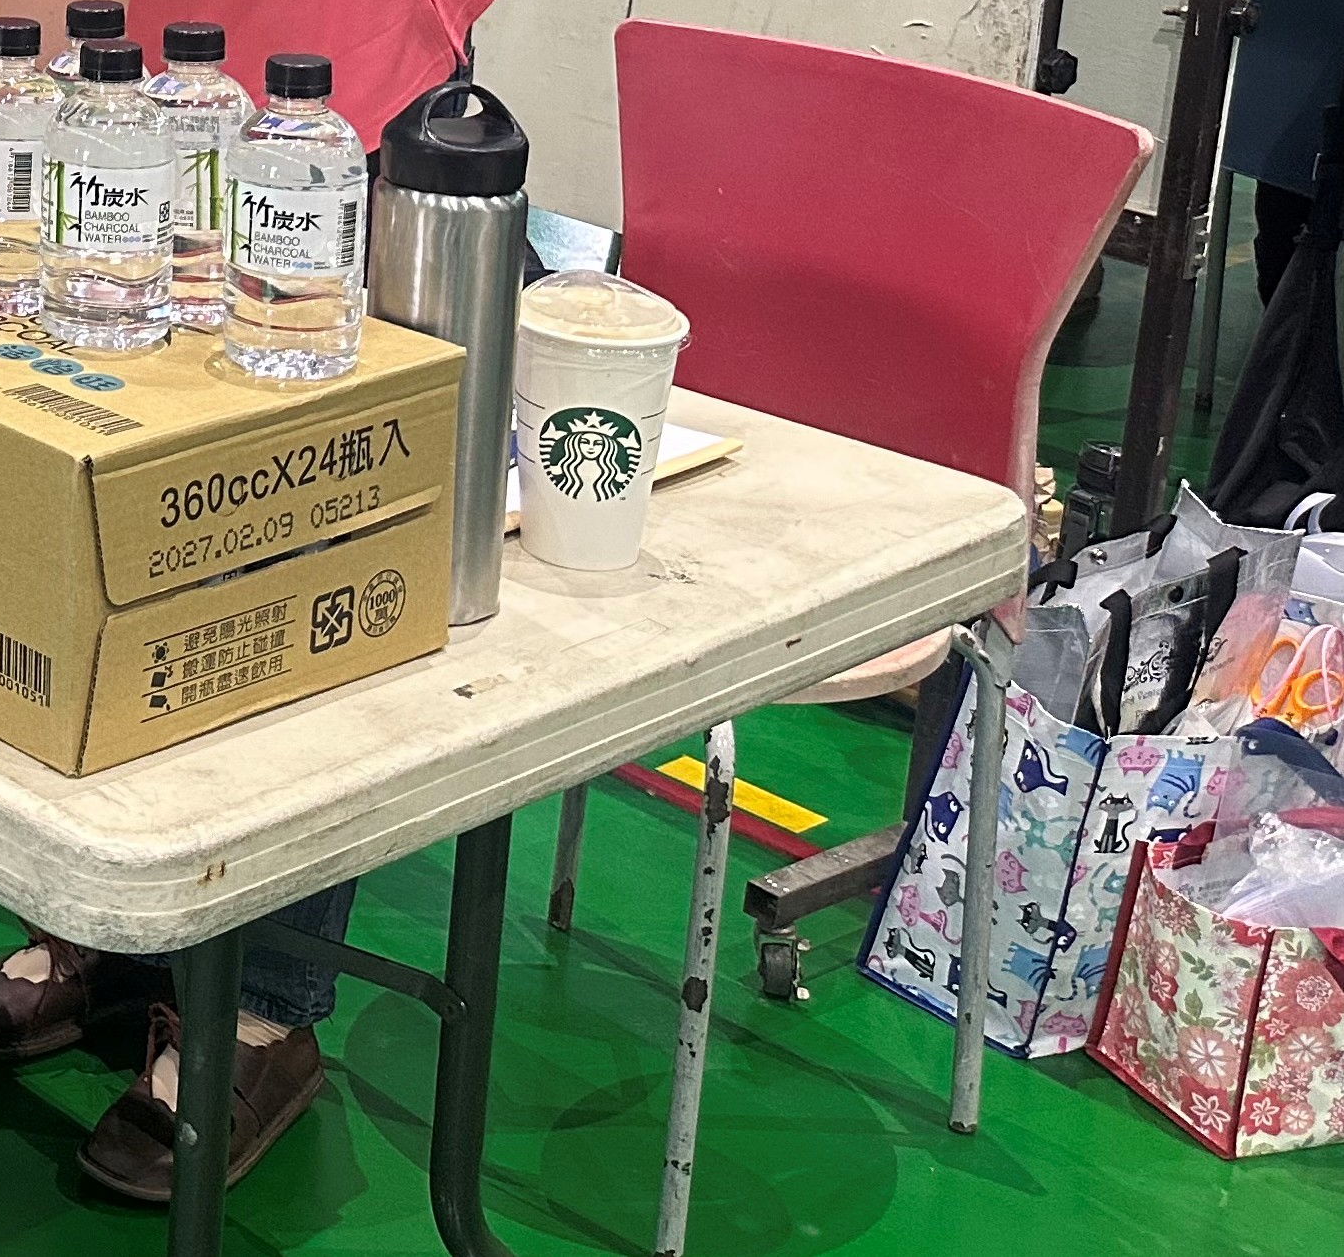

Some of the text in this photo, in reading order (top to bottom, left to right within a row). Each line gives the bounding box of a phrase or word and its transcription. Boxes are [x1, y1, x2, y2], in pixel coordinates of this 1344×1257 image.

[70, 172, 150, 208] 竹炭水
[84, 210, 130, 222] BAMBOO
[242, 191, 324, 232] 竹炭水
[84, 222, 141, 233] CHARCOAL
[84, 233, 122, 243] WATER
[254, 232, 301, 247] BAMBOO
[253, 243, 312, 259] CHARCOAL
[253, 253, 291, 269] WATER
[160, 418, 411, 528] 360ccX24瓶入
[148, 485, 381, 579] 2027.02.09 05213
[369, 588, 397, 610] 1000
